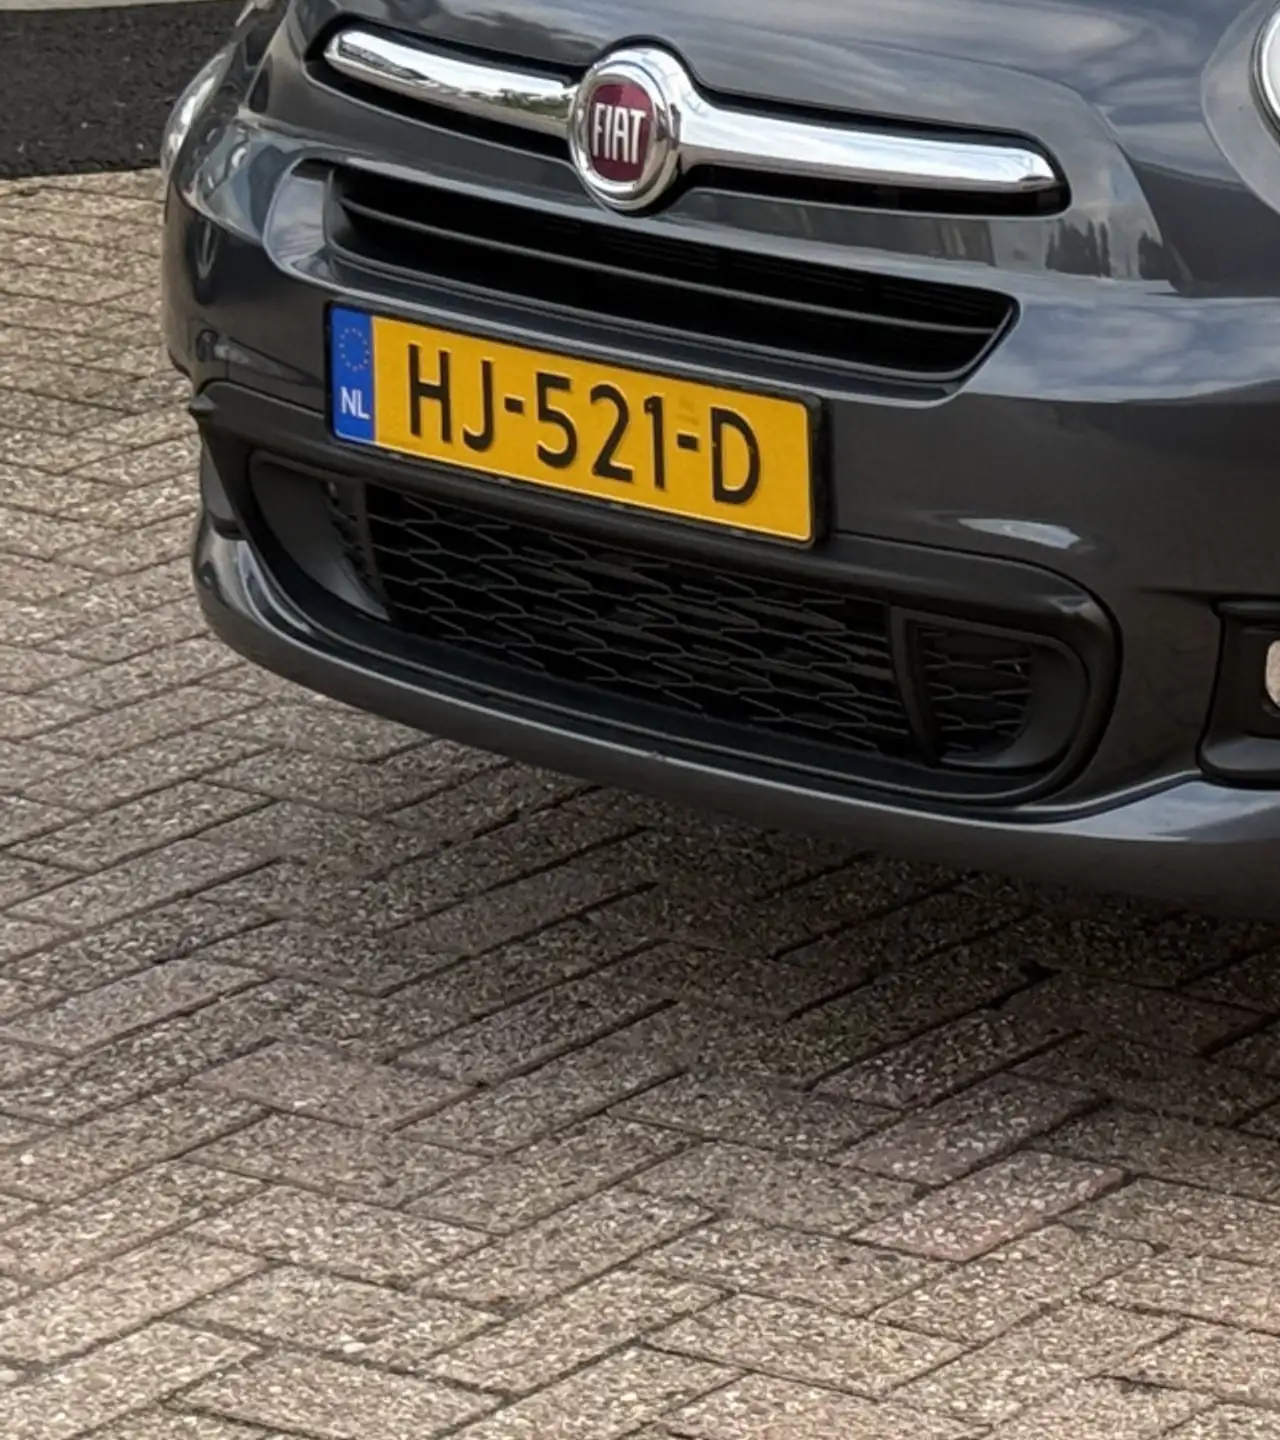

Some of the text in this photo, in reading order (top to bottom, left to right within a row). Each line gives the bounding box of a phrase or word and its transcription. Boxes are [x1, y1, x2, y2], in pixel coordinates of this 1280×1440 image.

[592, 102, 647, 165] FIAT
[339, 386, 371, 420] NL
[407, 342, 762, 506] HJ-521-D
